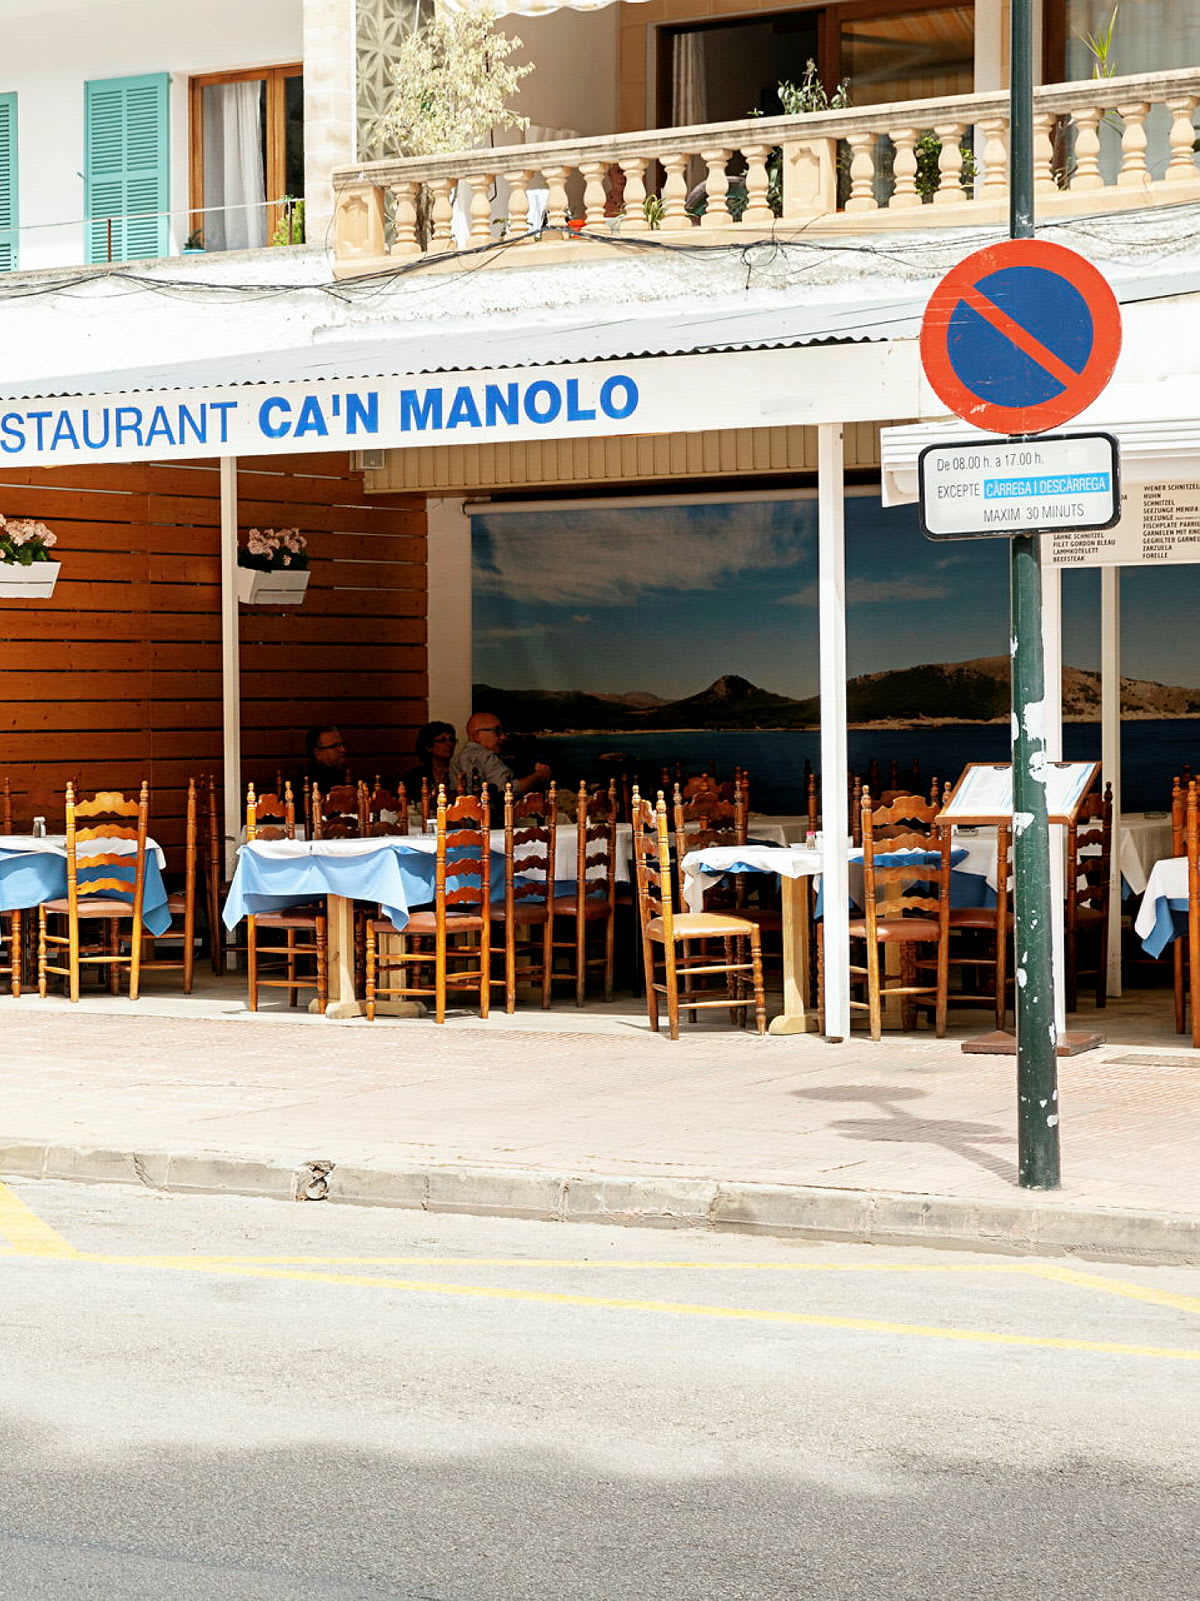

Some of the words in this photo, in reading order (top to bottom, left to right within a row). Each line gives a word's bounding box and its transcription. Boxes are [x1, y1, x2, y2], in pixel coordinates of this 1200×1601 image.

[258, 391, 378, 438] CA'N
[399, 375, 639, 431] MANOLO
[937, 459, 950, 471] De
[953, 456, 981, 470] 08.00
[984, 456, 992, 468] h.
[996, 458, 1001, 468] a
[1005, 452, 1032, 466] 17.00
[1035, 452, 1044, 464] h.
[938, 484, 980, 499] EXCEPTE
[1033, 482, 1036, 494] I
[984, 508, 1020, 522] MAXIM
[1027, 506, 1039, 520] 30
[1042, 504, 1084, 518] MINUTS
